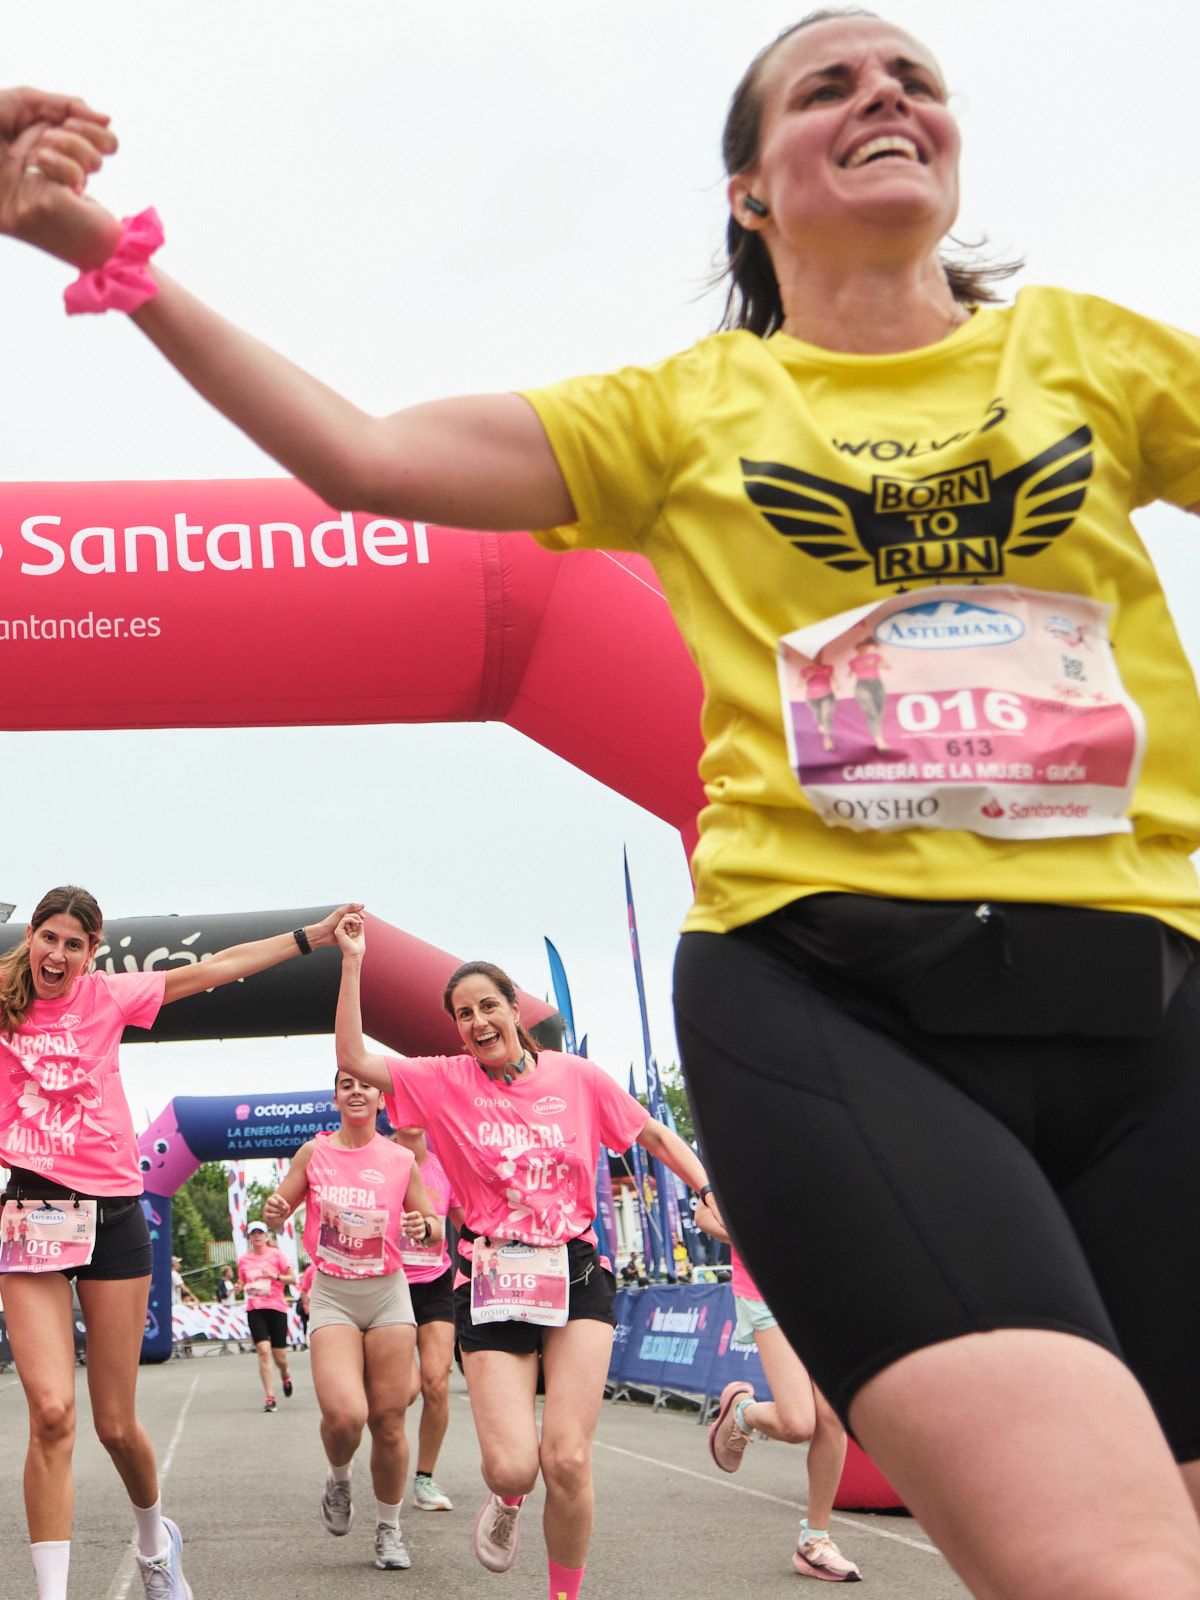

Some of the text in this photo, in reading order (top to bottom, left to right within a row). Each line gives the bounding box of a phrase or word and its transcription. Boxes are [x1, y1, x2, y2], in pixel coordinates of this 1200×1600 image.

[881, 469, 984, 510] BORN
[906, 510, 959, 539] TO
[19, 510, 433, 578] Santander
[885, 539, 995, 578] RUN
[886, 622, 1017, 641] ASTURIANA
[896, 689, 1028, 733] 016
[946, 738, 993, 757] 613
[842, 763, 918, 781] CARRERA
[923, 763, 946, 780] DE
[950, 763, 973, 779] LA
[976, 763, 1034, 780] MUJER
[1046, 761, 1087, 781] GIJÓN
[833, 797, 1090, 820] OYSHO Santander
[254, 1101, 314, 1119] octopus
[474, 1097, 512, 1109] OYSHO
[40, 1102, 62, 1131] LA
[227, 1128, 242, 1138] LA
[243, 1123, 291, 1137] ENERGÍA
[293, 1122, 323, 1134] PARA
[479, 1121, 566, 1149] CARRERA
[6, 1126, 76, 1157] MUJER
[227, 1141, 236, 1149] A
[238, 1141, 253, 1149] LA
[527, 1157, 557, 1191] DE
[26, 1239, 62, 1256] 016
[338, 1233, 364, 1249] 016
[498, 1273, 537, 1288] 016
